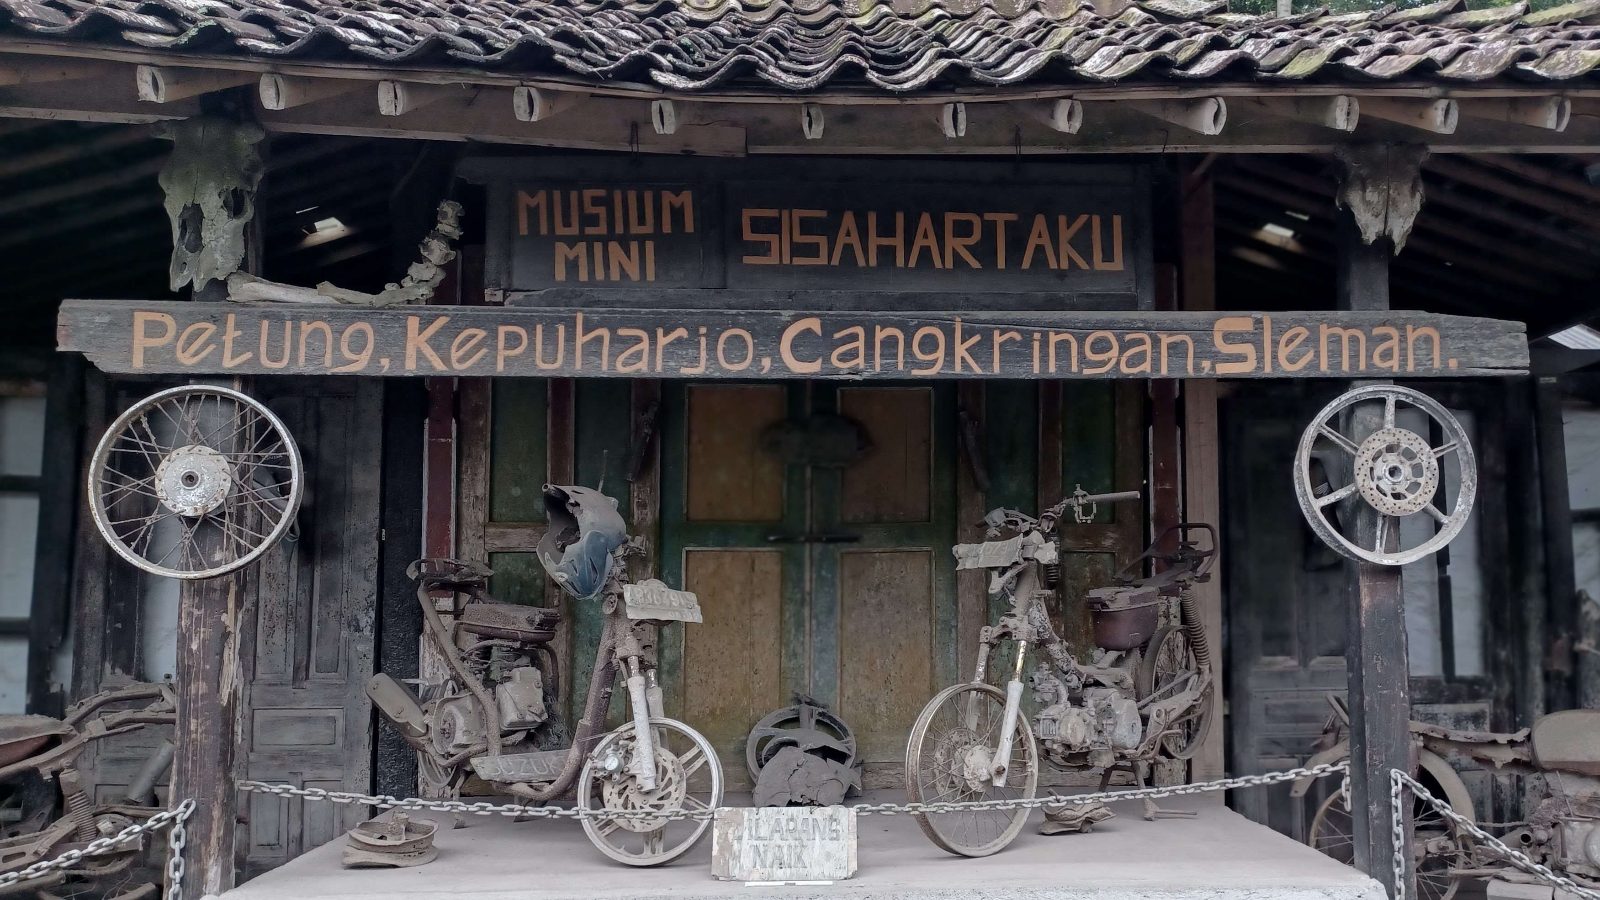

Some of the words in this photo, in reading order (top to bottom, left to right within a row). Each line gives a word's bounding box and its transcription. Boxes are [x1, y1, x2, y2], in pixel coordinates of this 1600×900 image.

[517, 189, 694, 236] MUSIUM
[554, 242, 655, 282] MINI
[1213, 316, 1457, 374] Sleman.
